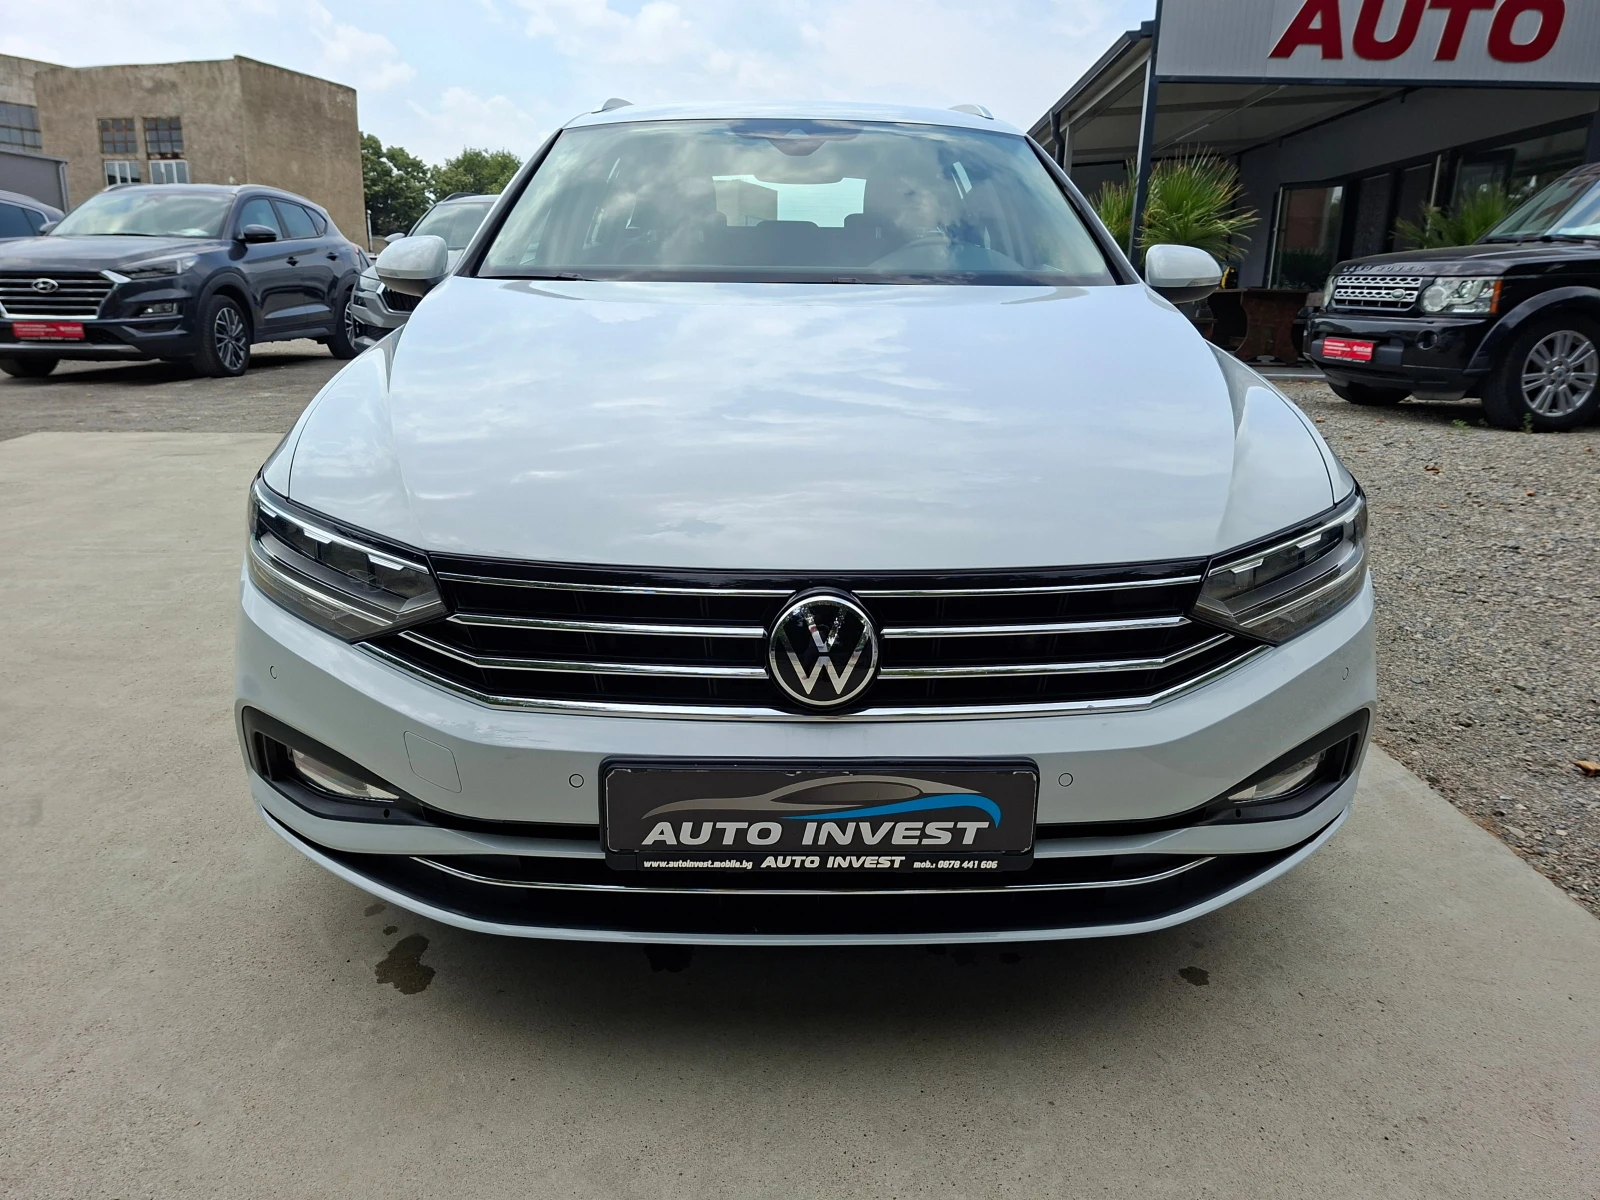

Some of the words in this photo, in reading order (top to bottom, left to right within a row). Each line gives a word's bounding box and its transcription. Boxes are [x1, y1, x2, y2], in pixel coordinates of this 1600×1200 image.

[1267, 0, 1566, 63] AUTO
[641, 822, 783, 846] AUTO
[801, 821, 990, 846] INVEST
[643, 859, 753, 870] www.autoinvest.mobile.bg
[760, 856, 820, 869] AUTO
[826, 856, 906, 869] INVEST
[937, 860, 960, 869] 0878
[961, 860, 978, 869] 441
[980, 860, 998, 869] 606
